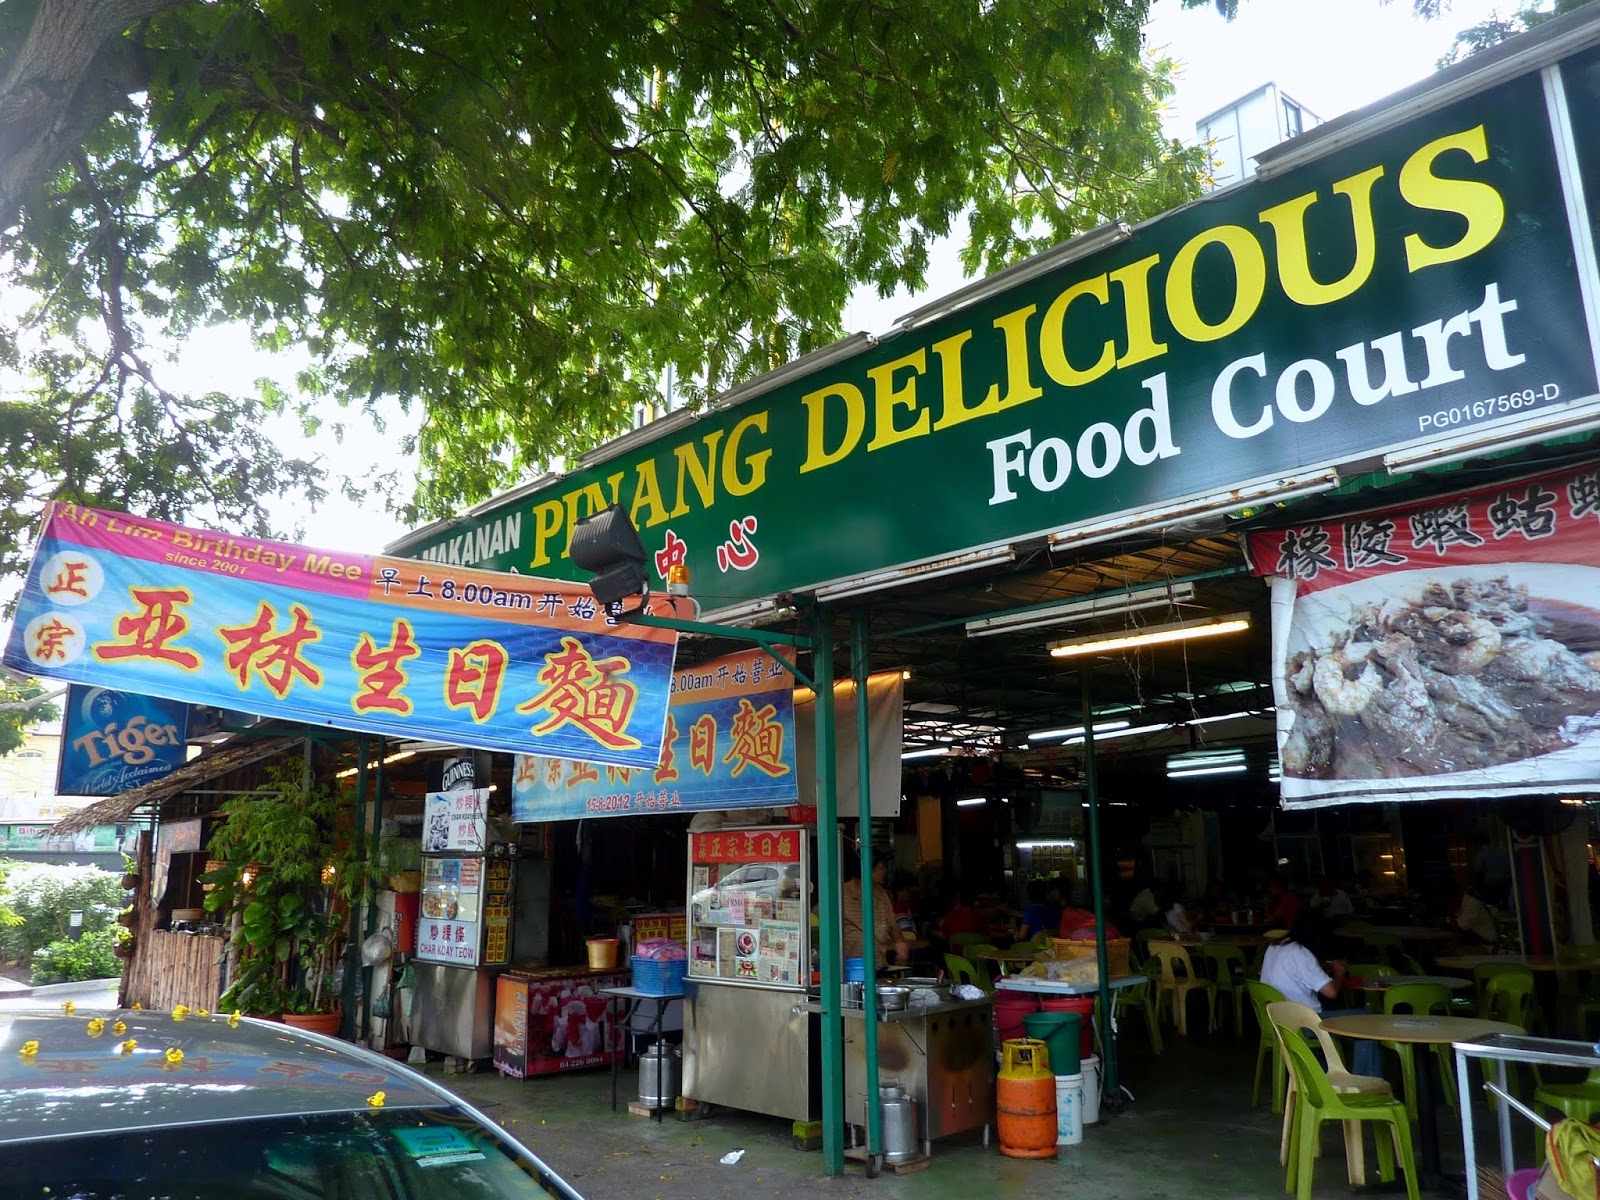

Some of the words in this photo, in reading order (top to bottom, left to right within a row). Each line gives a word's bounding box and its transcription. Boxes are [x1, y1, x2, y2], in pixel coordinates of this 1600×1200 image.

[800, 125, 1506, 473] DELICIOUS
[986, 372, 1181, 505] Food
[1211, 282, 1527, 440] Court
[1418, 383, 1560, 432] PG0167569-D
[165, 551, 207, 567] since
[172, 529, 295, 573] Birthday
[304, 554, 362, 580] Mee
[73, 715, 180, 768] Tiger
[442, 762, 474, 791] GUINNESS
[420, 943, 436, 955] CHAR
[455, 946, 475, 959] TEOW
